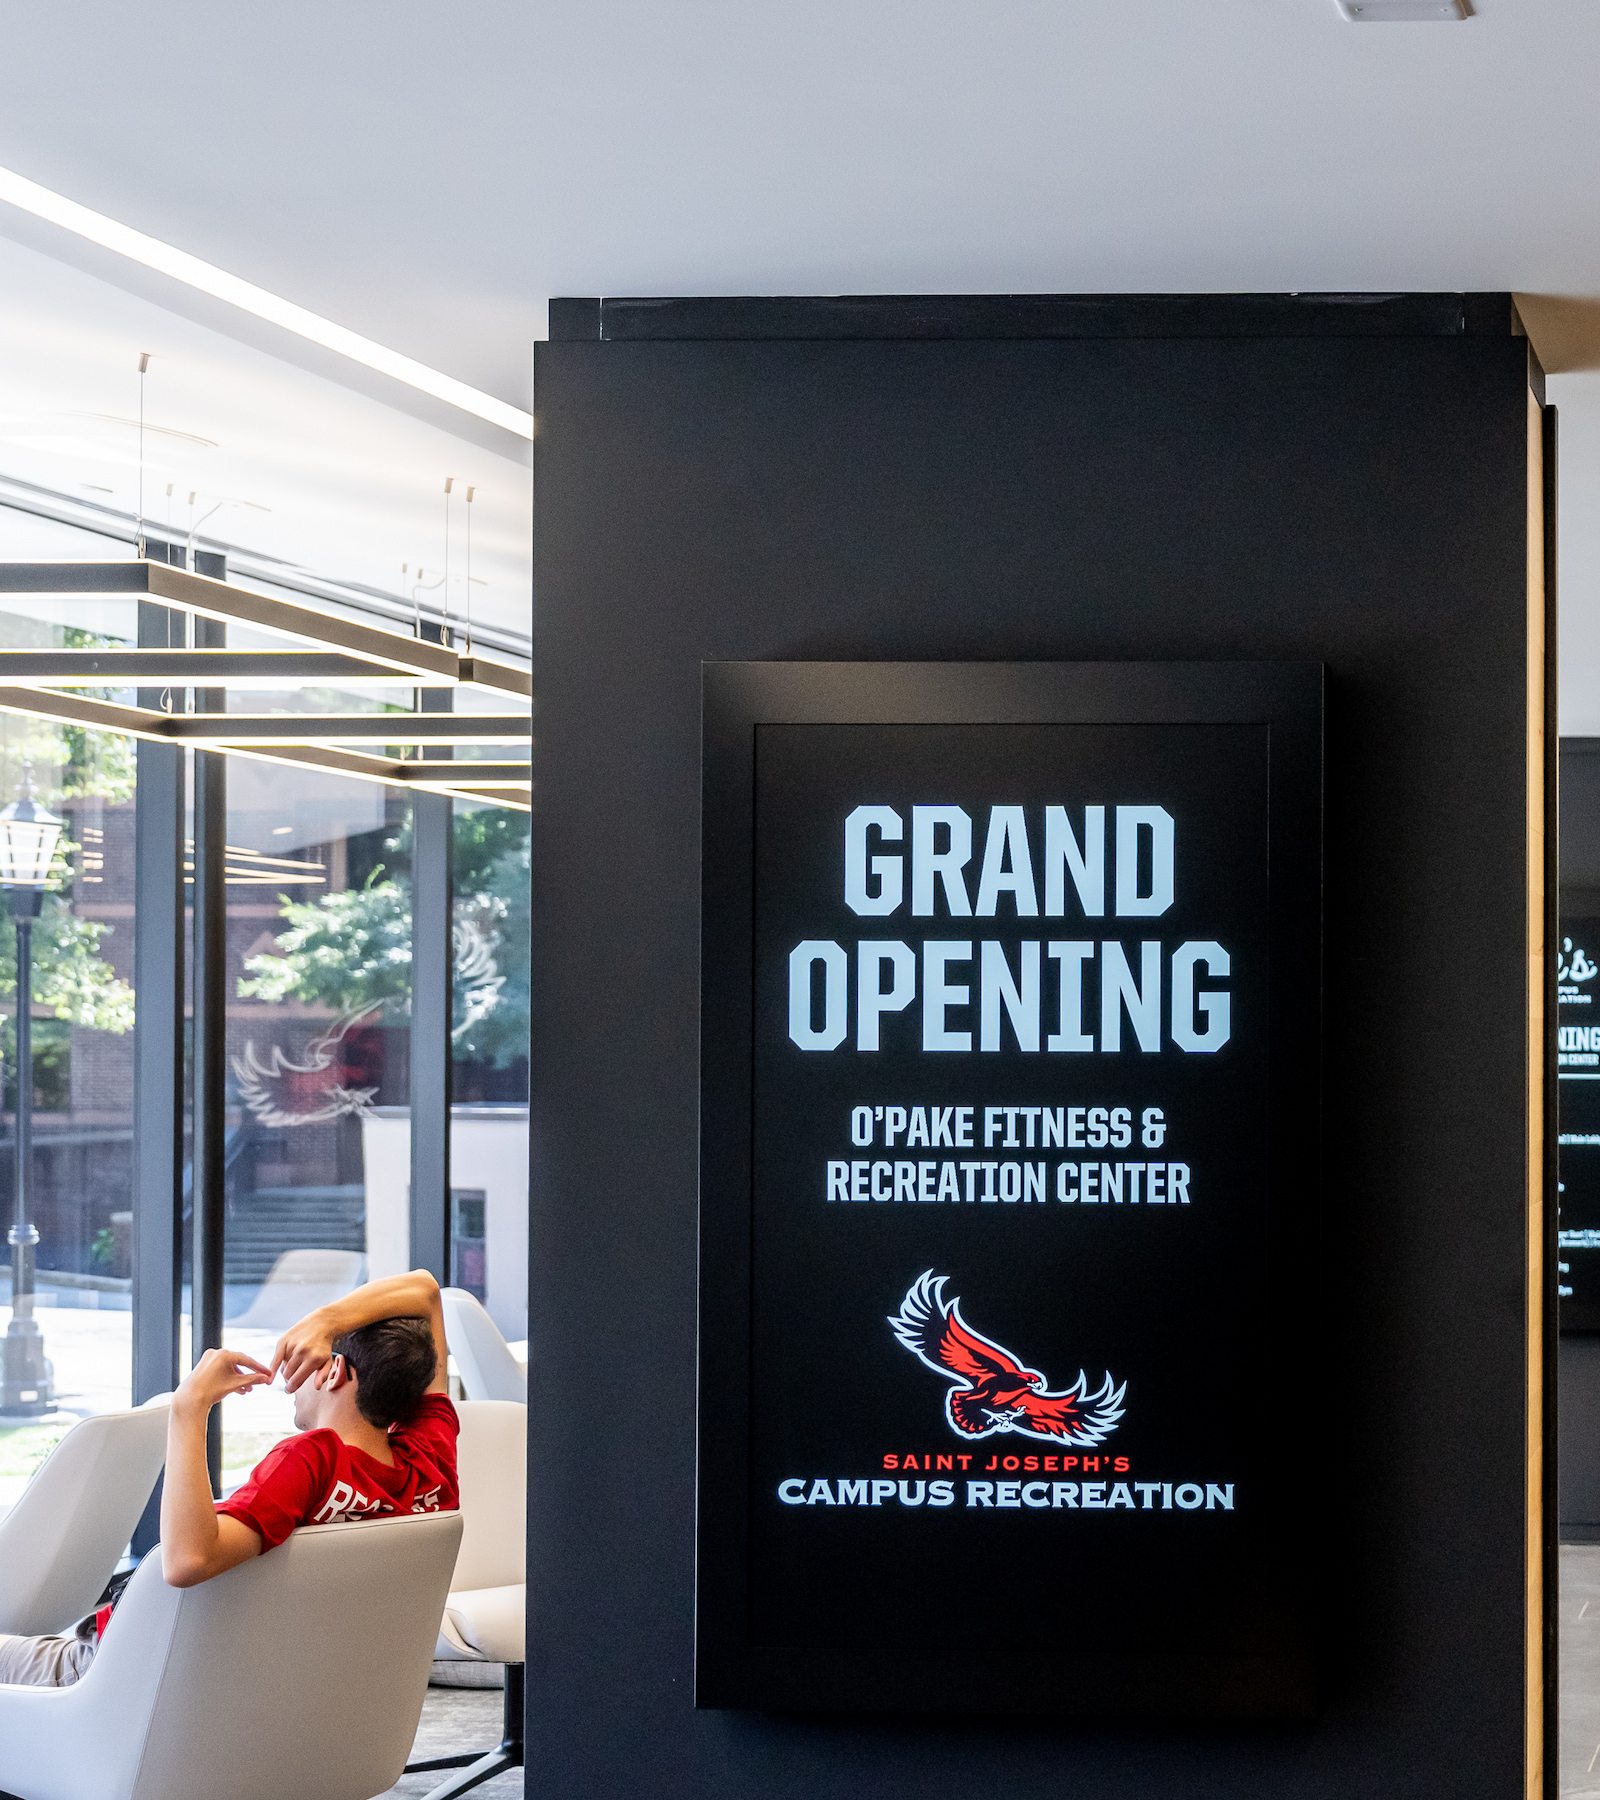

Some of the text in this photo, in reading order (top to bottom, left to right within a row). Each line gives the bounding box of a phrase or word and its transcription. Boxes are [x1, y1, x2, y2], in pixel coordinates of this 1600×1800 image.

[844, 804, 1175, 917] GRAND
[788, 940, 1230, 1053] OPENING
[1568, 1053, 1599, 1066] CENTER
[851, 1105, 1167, 1148] O'PAKE FITNESS &
[826, 1160, 1190, 1204] RECREATION CENTER
[883, 1454, 1130, 1472] SAINT JOSEPH'S
[777, 1478, 1235, 1510] CAMPUS RECREATION
